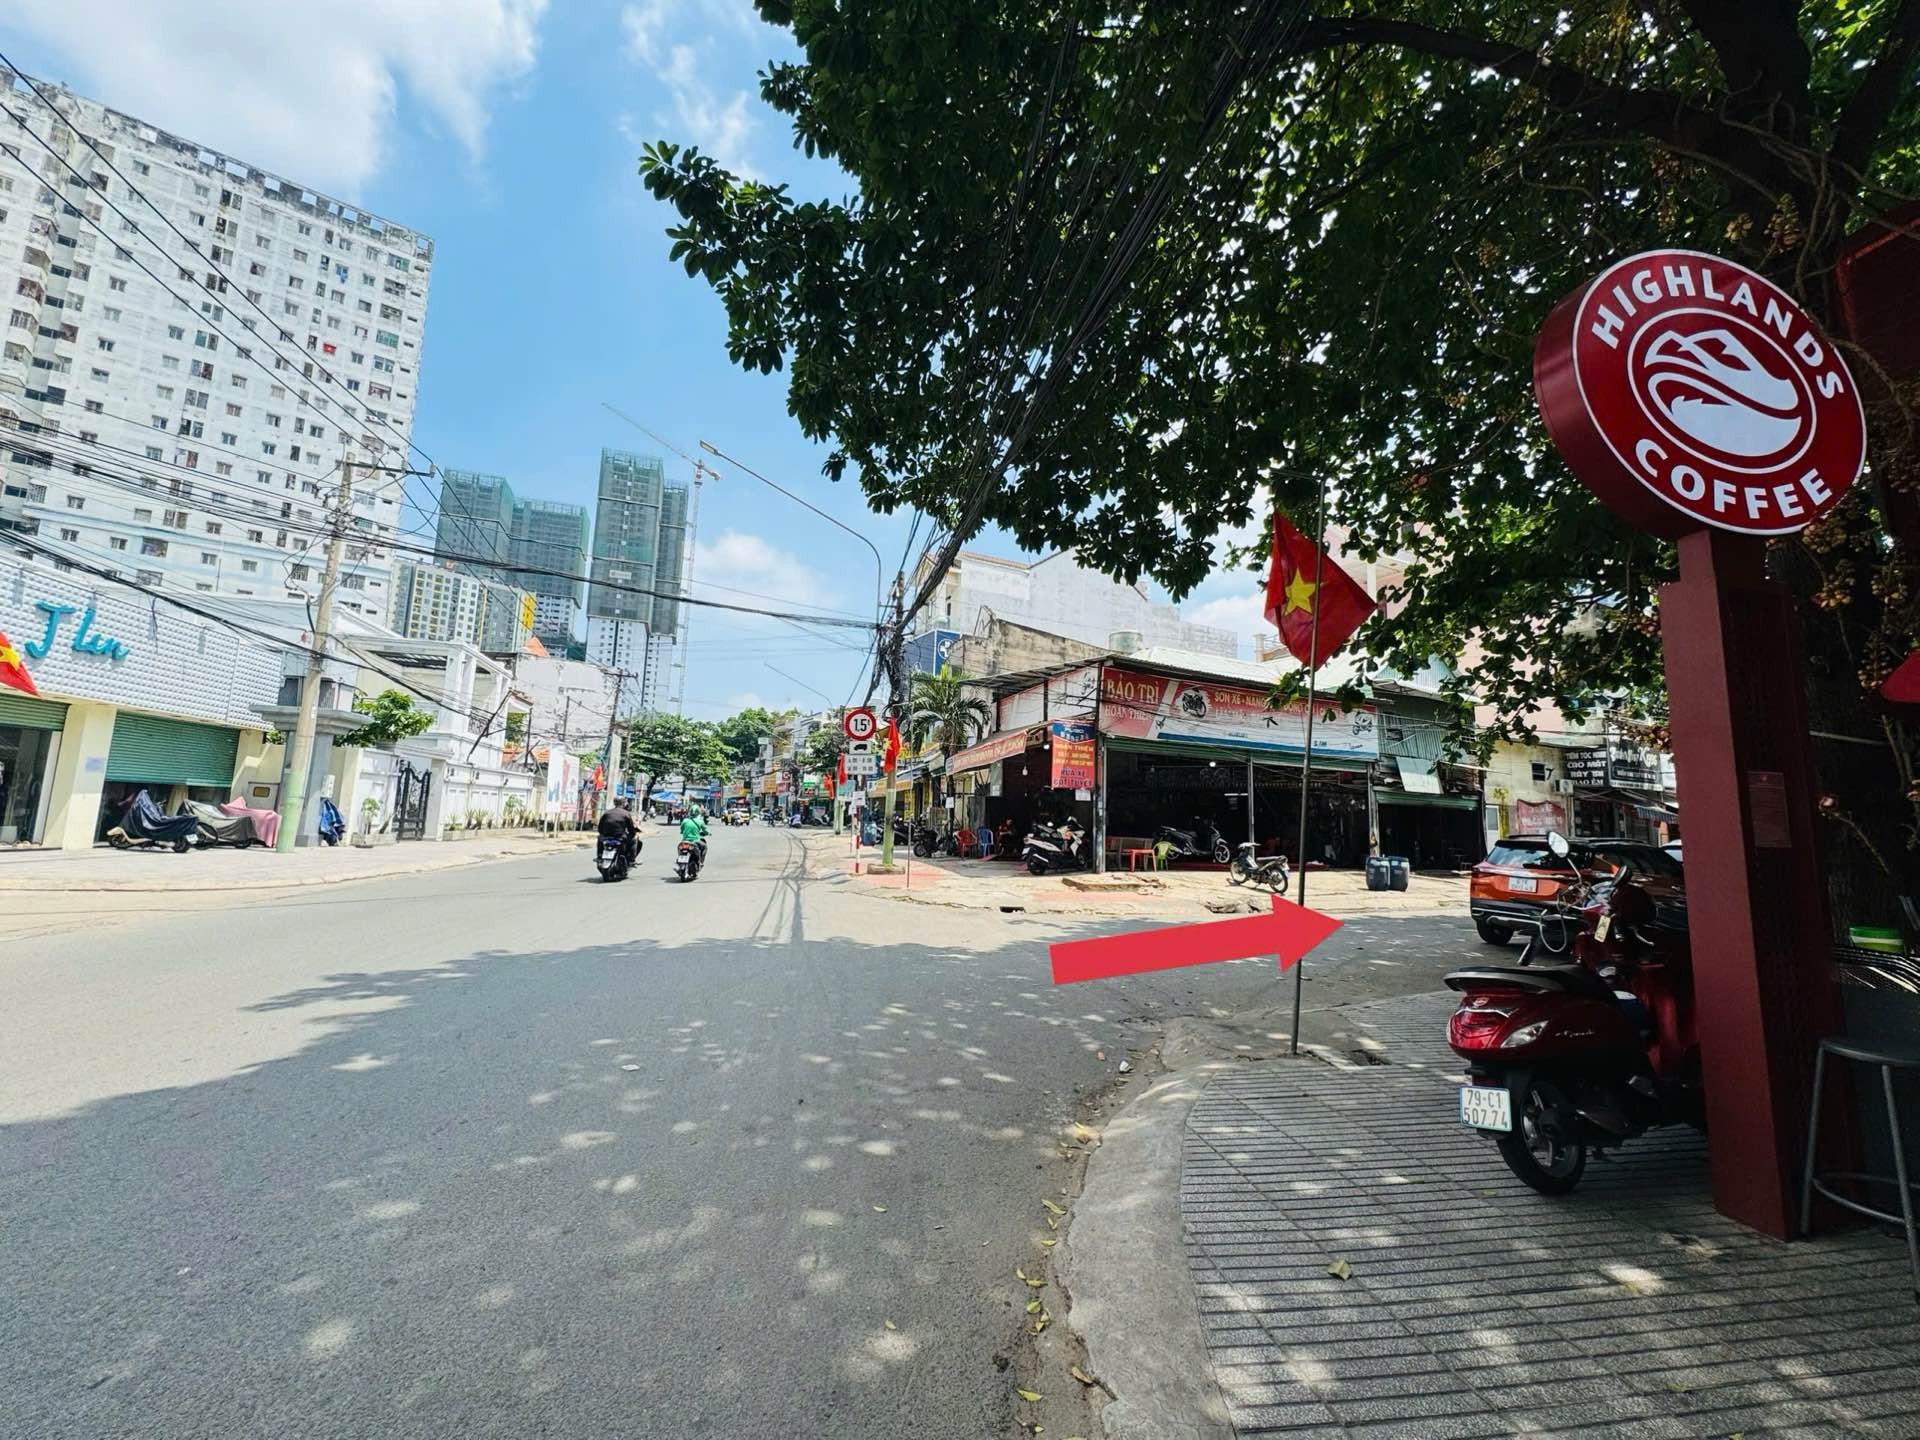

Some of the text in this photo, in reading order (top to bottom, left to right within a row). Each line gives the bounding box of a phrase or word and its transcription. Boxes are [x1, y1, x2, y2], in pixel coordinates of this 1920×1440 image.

[1591, 265, 1845, 400] HIGHLANDS
[1634, 437, 1833, 520] COFFEE
[1106, 673, 1160, 705] BẢO TRÌ
[1467, 1089, 1501, 1109] 79-C1
[1463, 1106, 1508, 1129] 507.74
